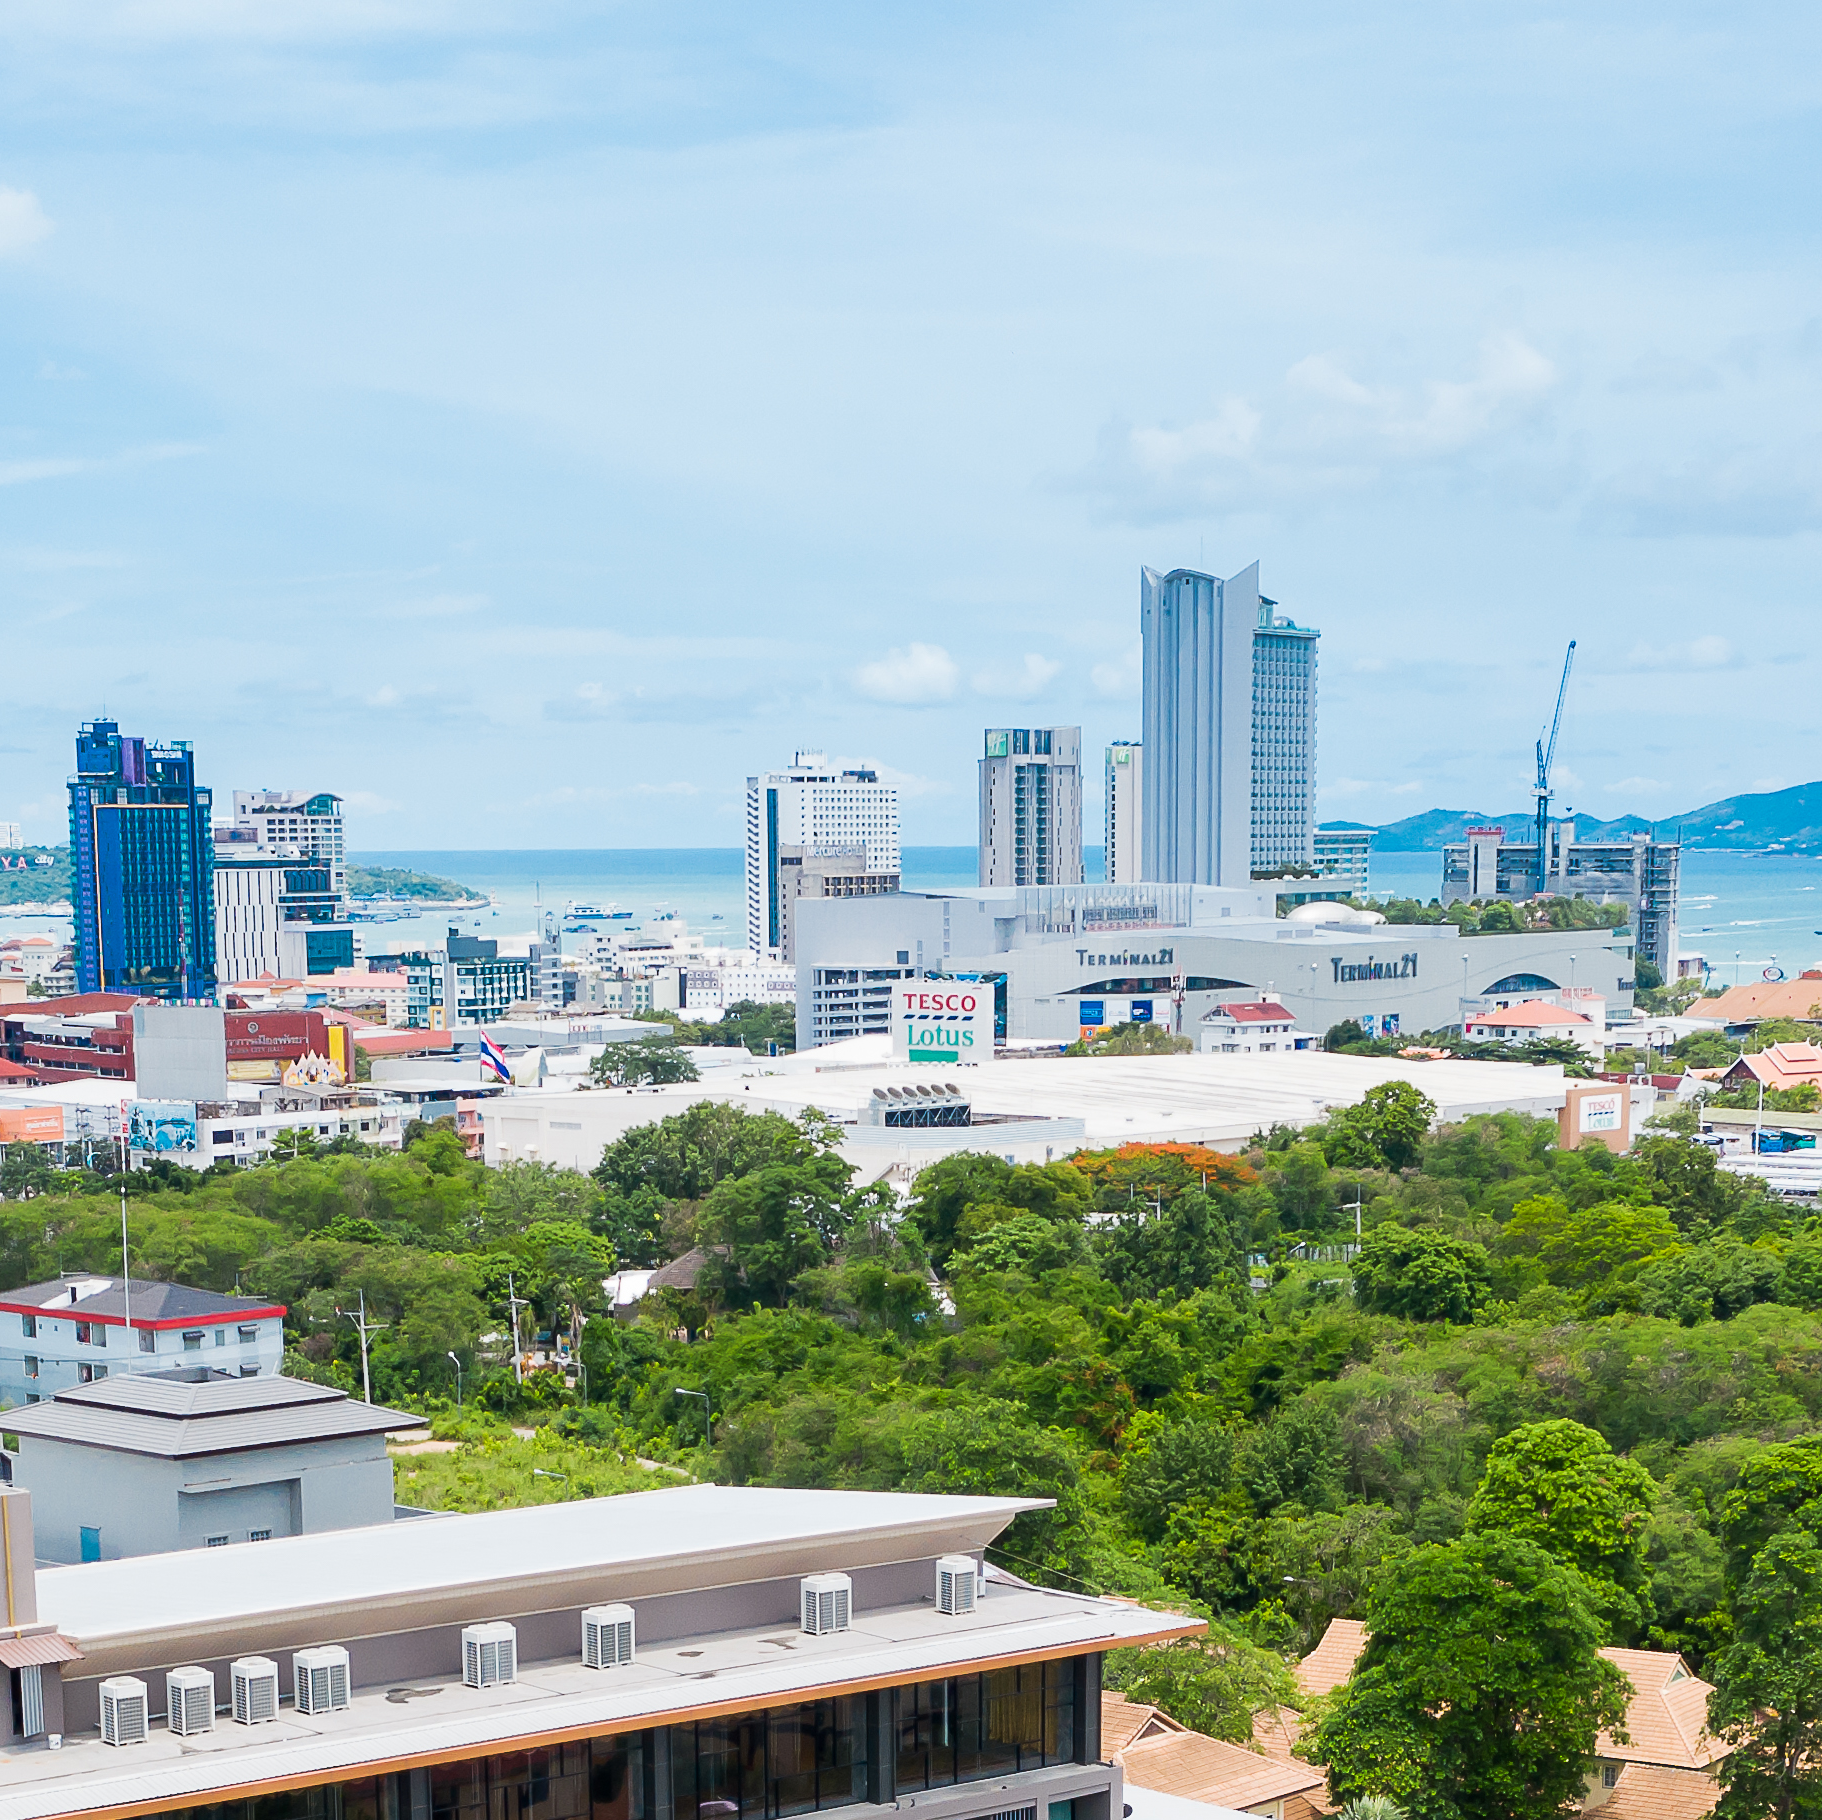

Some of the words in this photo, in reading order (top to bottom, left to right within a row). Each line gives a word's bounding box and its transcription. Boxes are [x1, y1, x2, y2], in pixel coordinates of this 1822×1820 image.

[806, 845, 842, 857] Mercure
[902, 993, 977, 1013] TESCO
[907, 1023, 974, 1047] Lotus
[1587, 1098, 1615, 1113] TESCO
